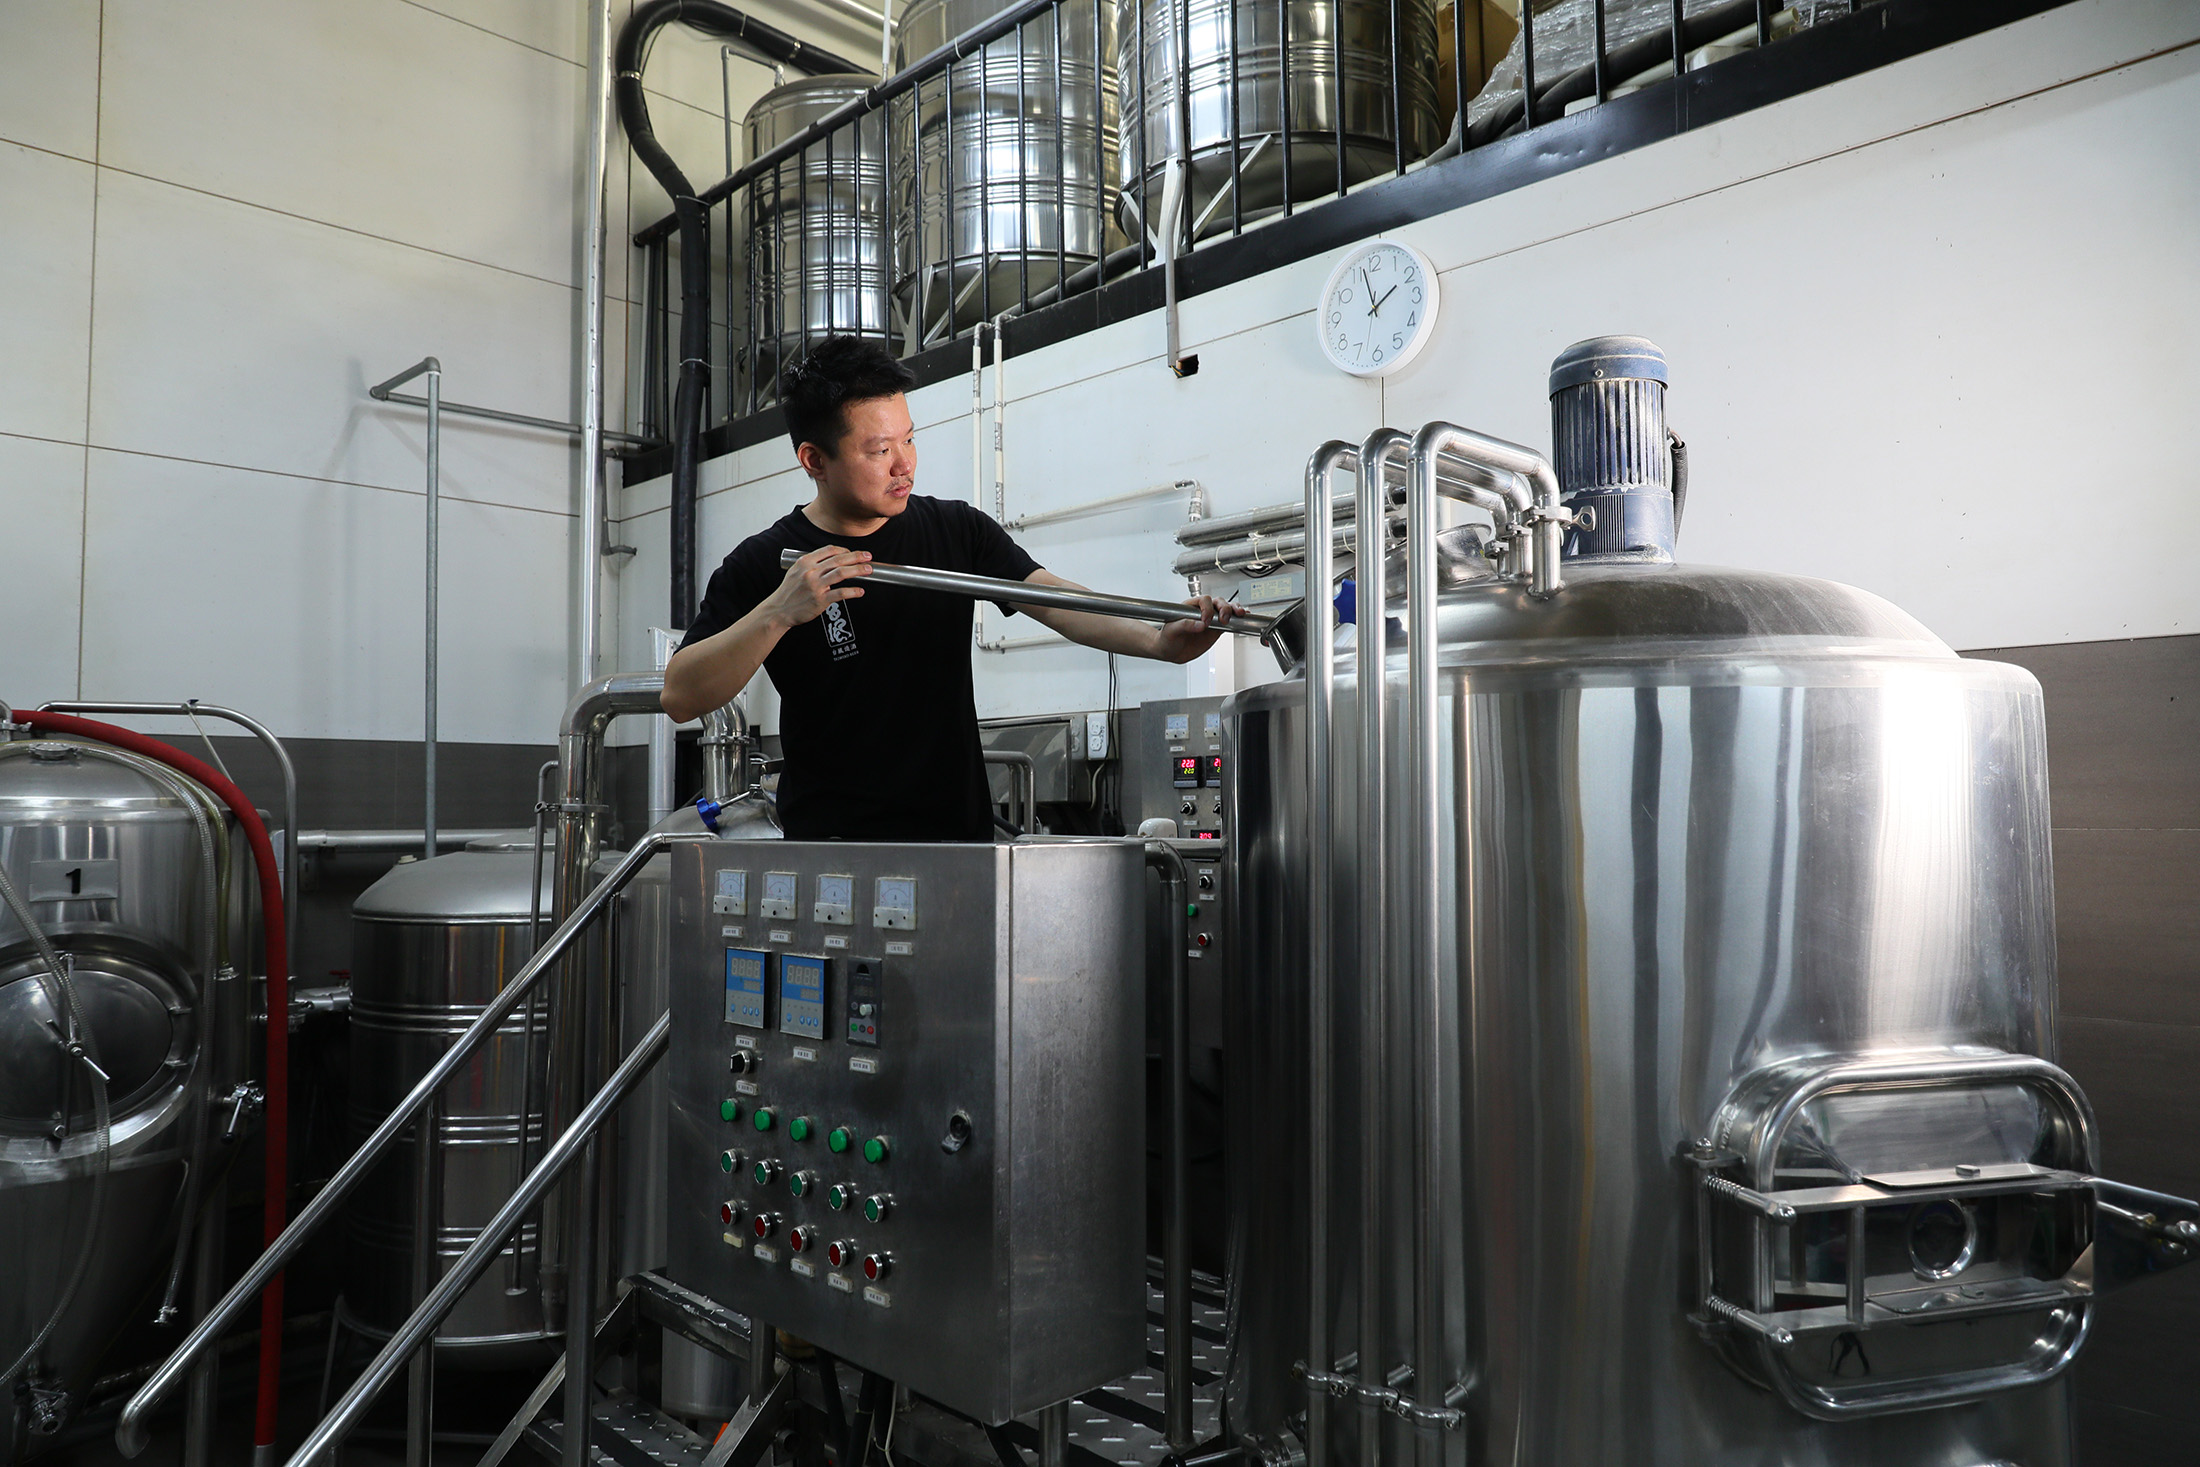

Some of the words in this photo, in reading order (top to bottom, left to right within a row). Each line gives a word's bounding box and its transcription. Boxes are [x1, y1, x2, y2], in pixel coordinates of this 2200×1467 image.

[1368, 254, 1381, 272] 12
[1393, 255, 1397, 272] 1
[1352, 266, 1363, 285] 11
[1403, 265, 1415, 284] 2
[1337, 287, 1354, 307] 10
[1411, 286, 1422, 304] 3
[1331, 311, 1342, 329] 9
[1406, 310, 1416, 327] 4
[1338, 333, 1348, 351] 8
[1392, 331, 1404, 350] 5
[1352, 342, 1363, 361] 7
[1371, 344, 1384, 362] 6
[65, 868, 81, 894] 1
